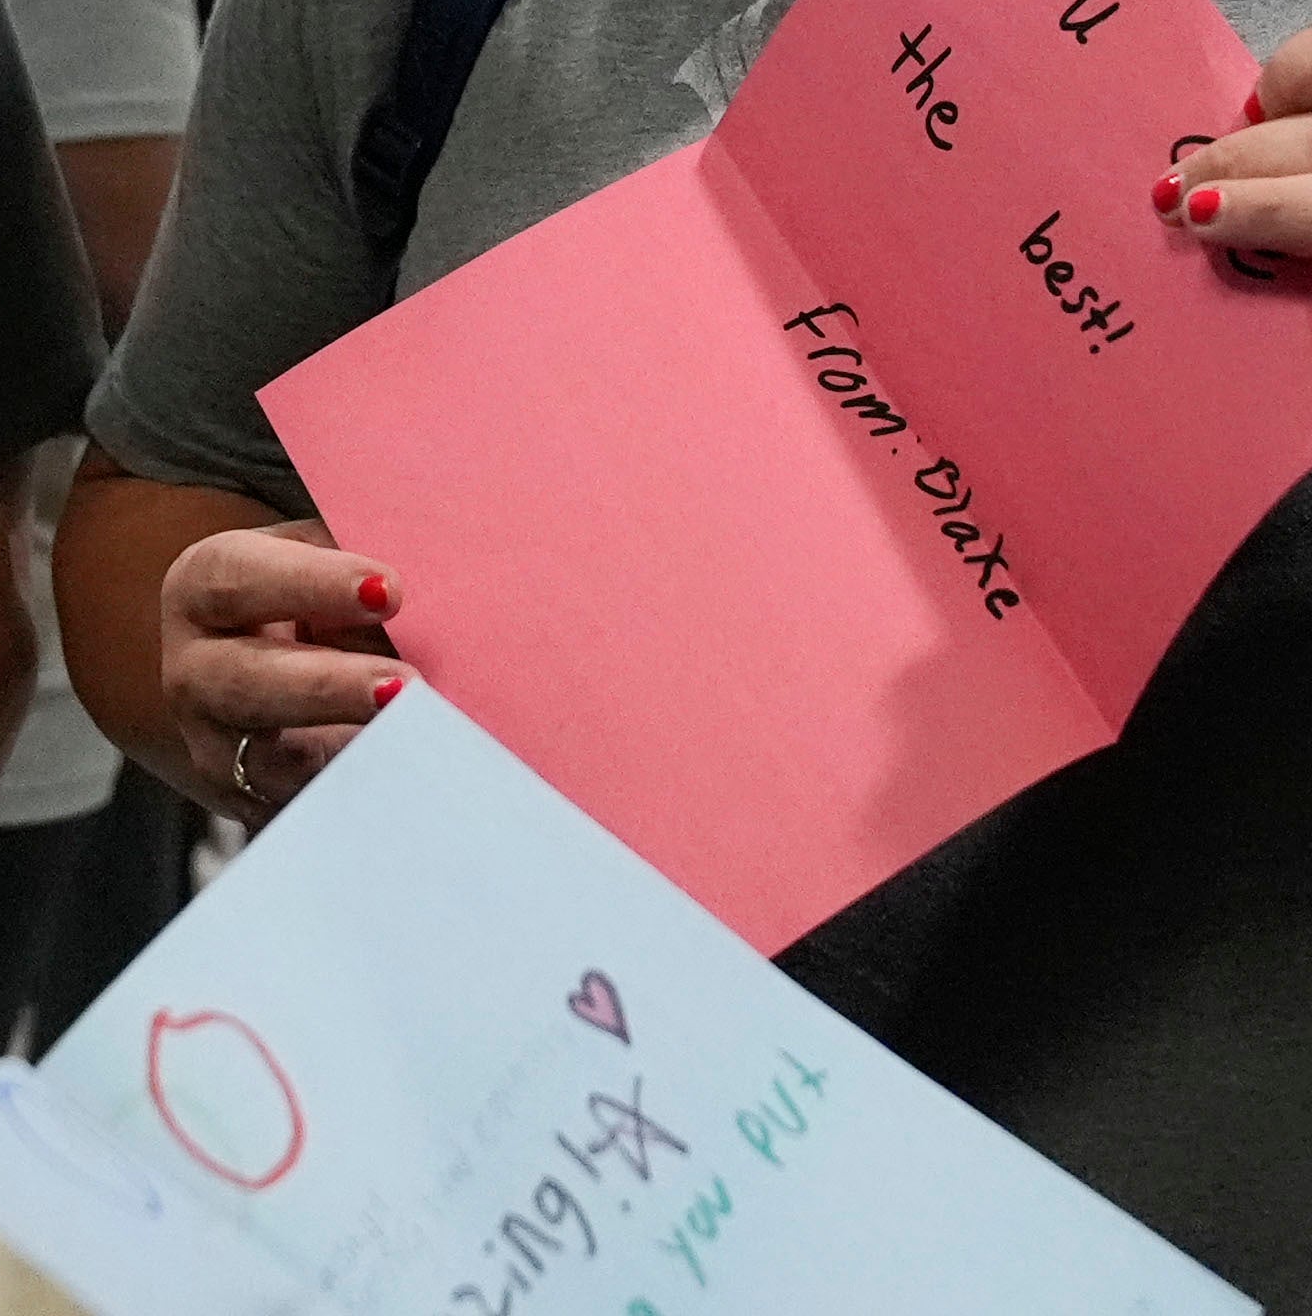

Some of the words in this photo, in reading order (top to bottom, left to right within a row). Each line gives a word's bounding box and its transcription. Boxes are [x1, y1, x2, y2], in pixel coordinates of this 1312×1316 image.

[890, 23, 959, 152] the
[1019, 209, 1136, 355] best!
[658, 1174, 733, 1287] you
